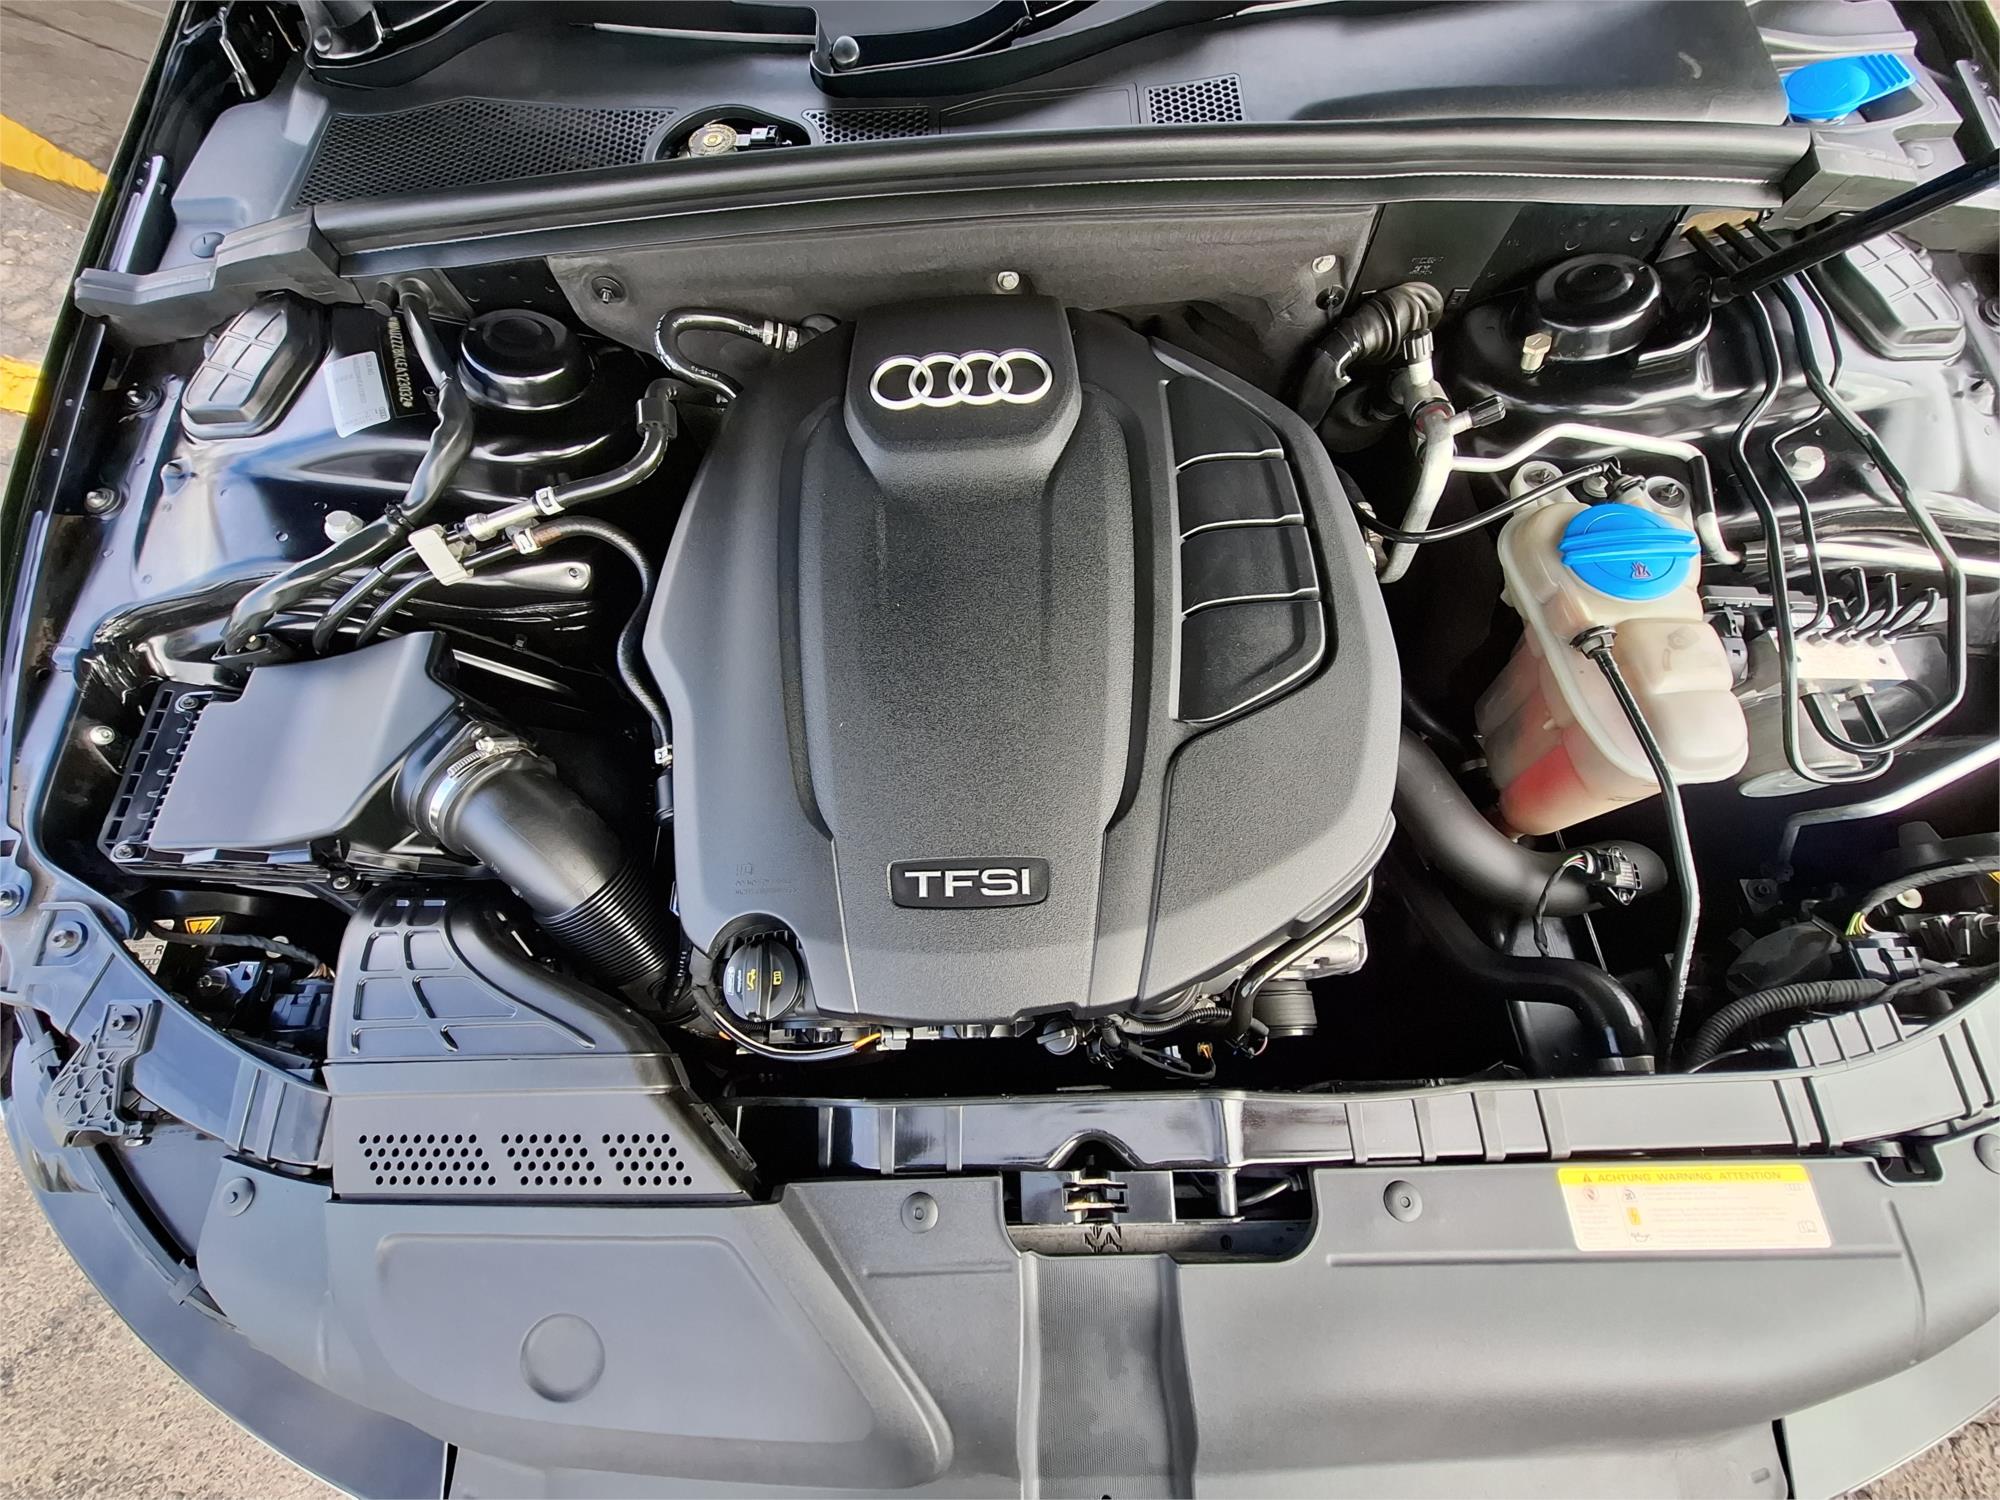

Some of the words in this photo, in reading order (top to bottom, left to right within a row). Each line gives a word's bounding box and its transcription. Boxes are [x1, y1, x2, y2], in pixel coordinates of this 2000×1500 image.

[904, 868, 1031, 898] TFSI
[154, 944, 164, 955] R
[1598, 1173, 1652, 1182] ACHTUNG
[1657, 1172, 1713, 1181] WARNING
[1719, 1171, 1781, 1180] ATTENTION
